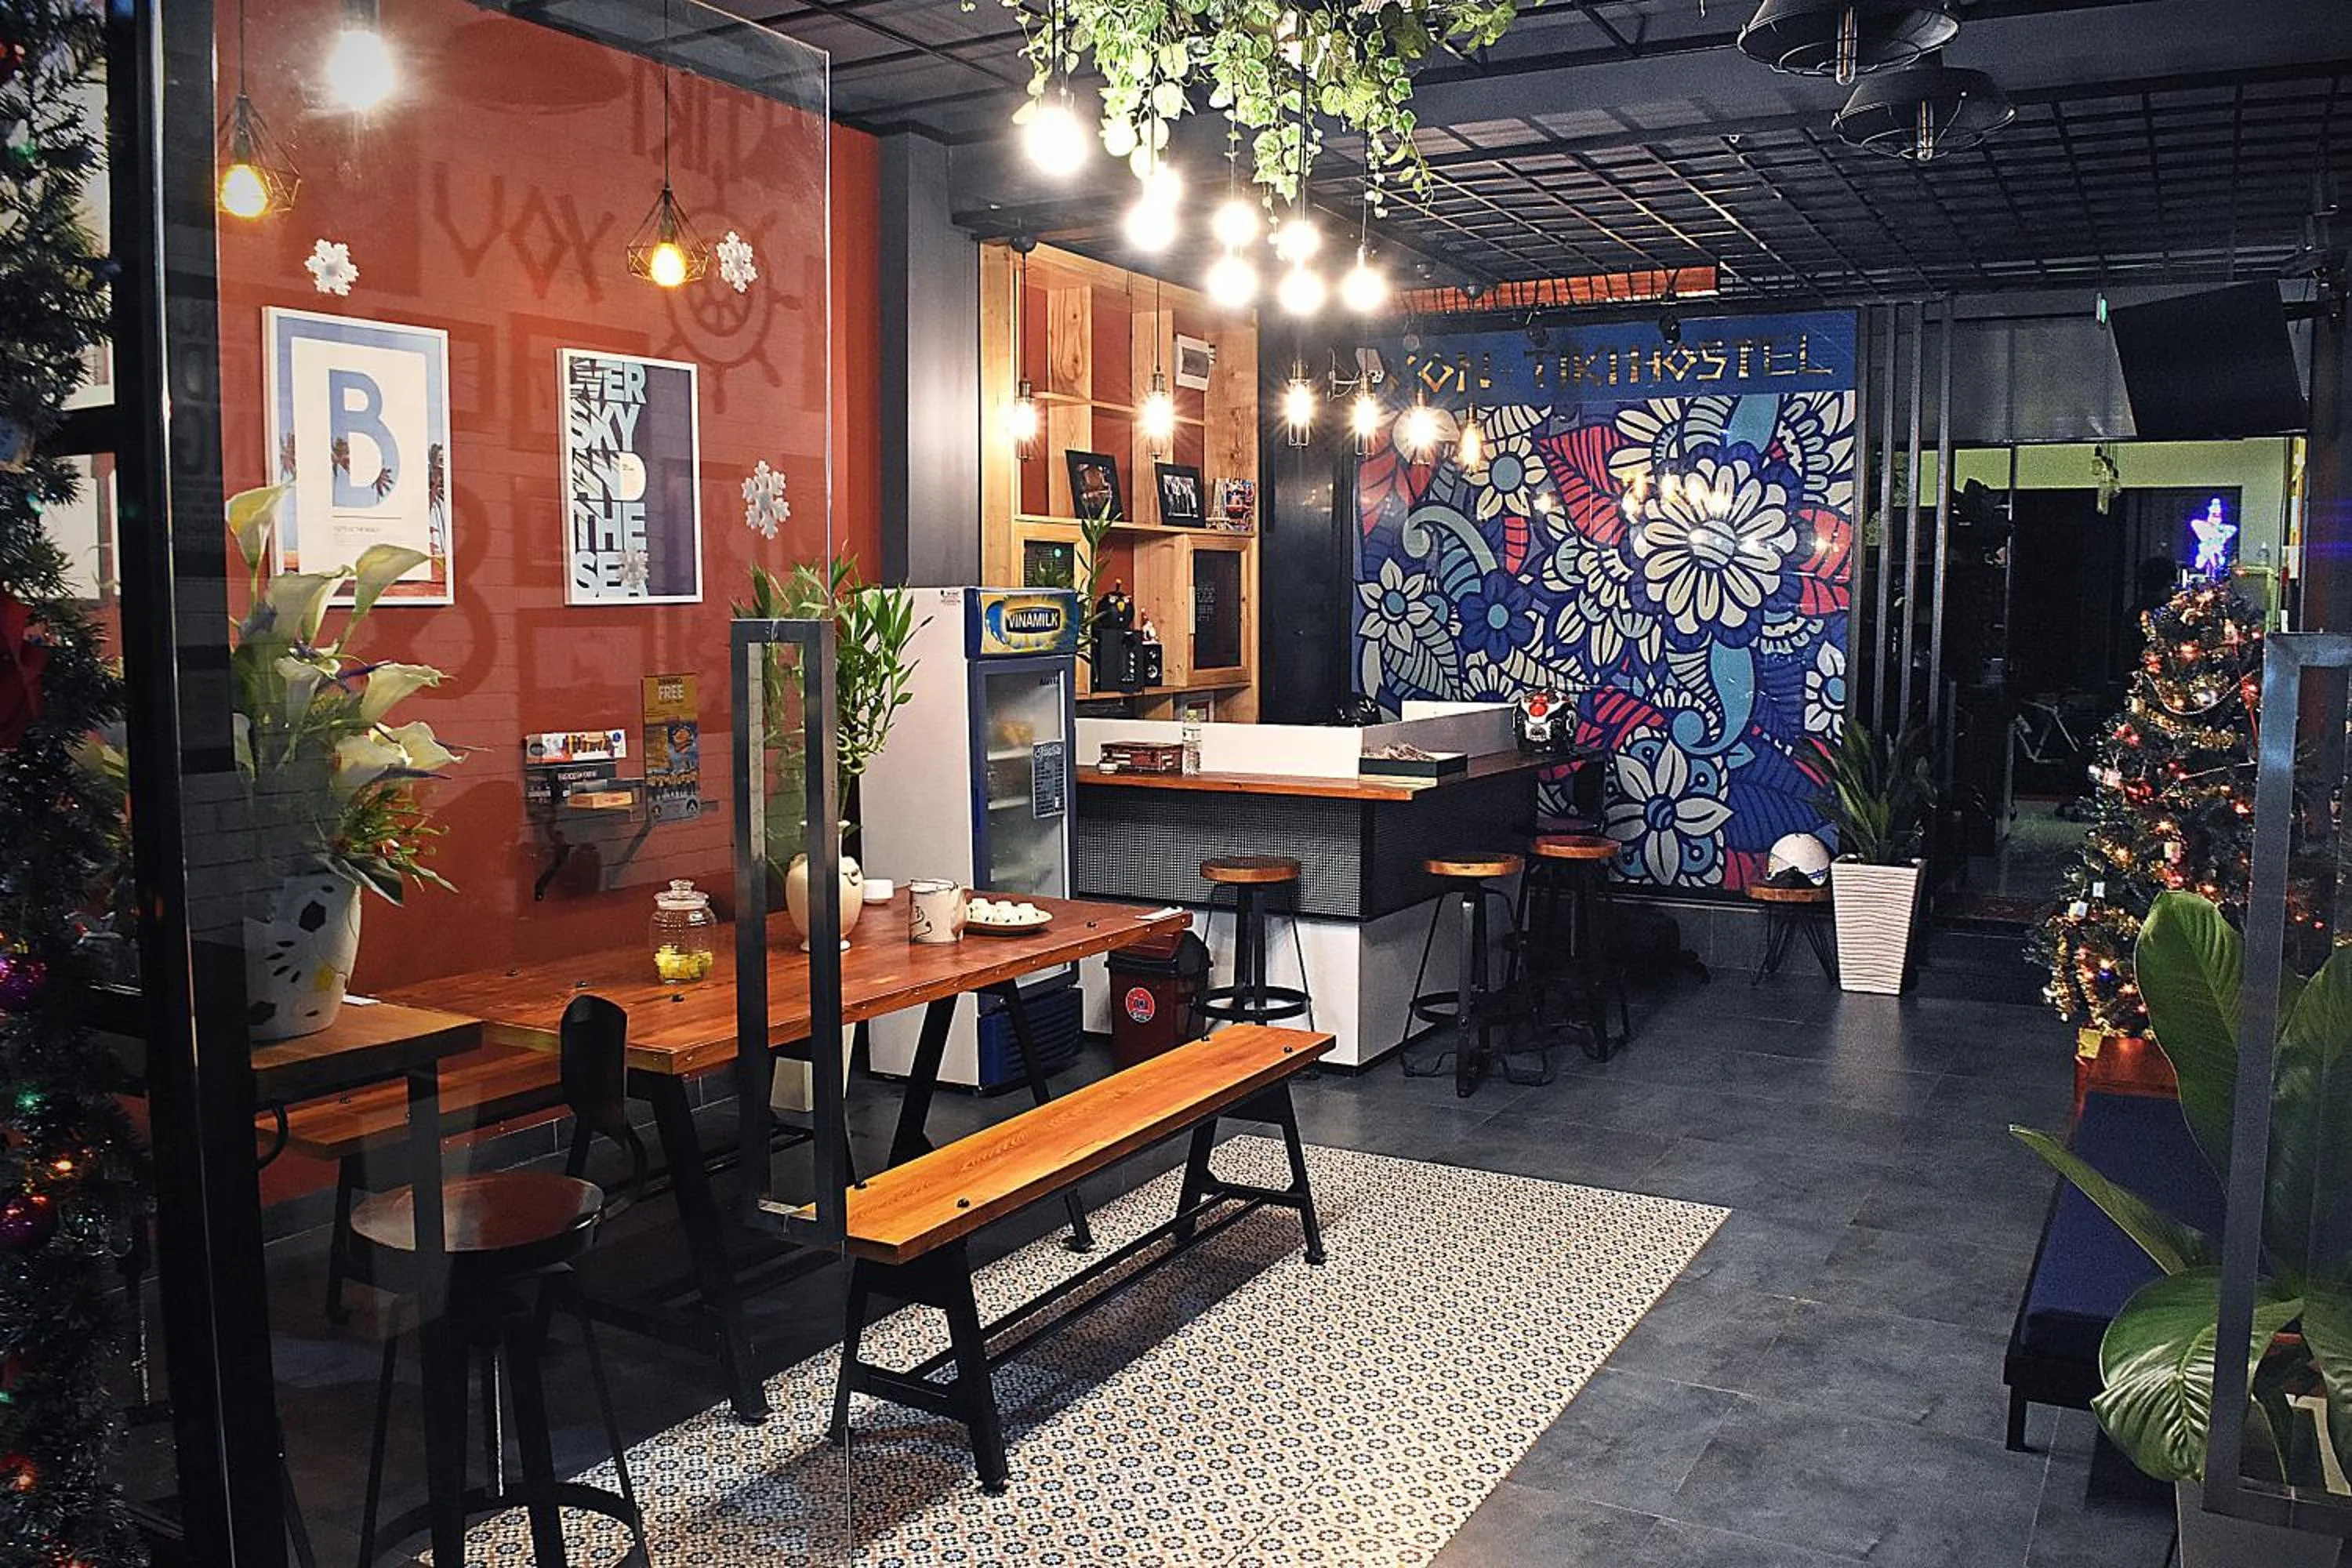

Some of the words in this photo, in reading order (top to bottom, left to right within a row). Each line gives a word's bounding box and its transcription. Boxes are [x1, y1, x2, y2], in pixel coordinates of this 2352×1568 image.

[328, 368, 401, 509] B
[573, 499, 647, 550] THE
[1006, 612, 1058, 628] VINAMILK
[659, 685, 684, 700] FREE
